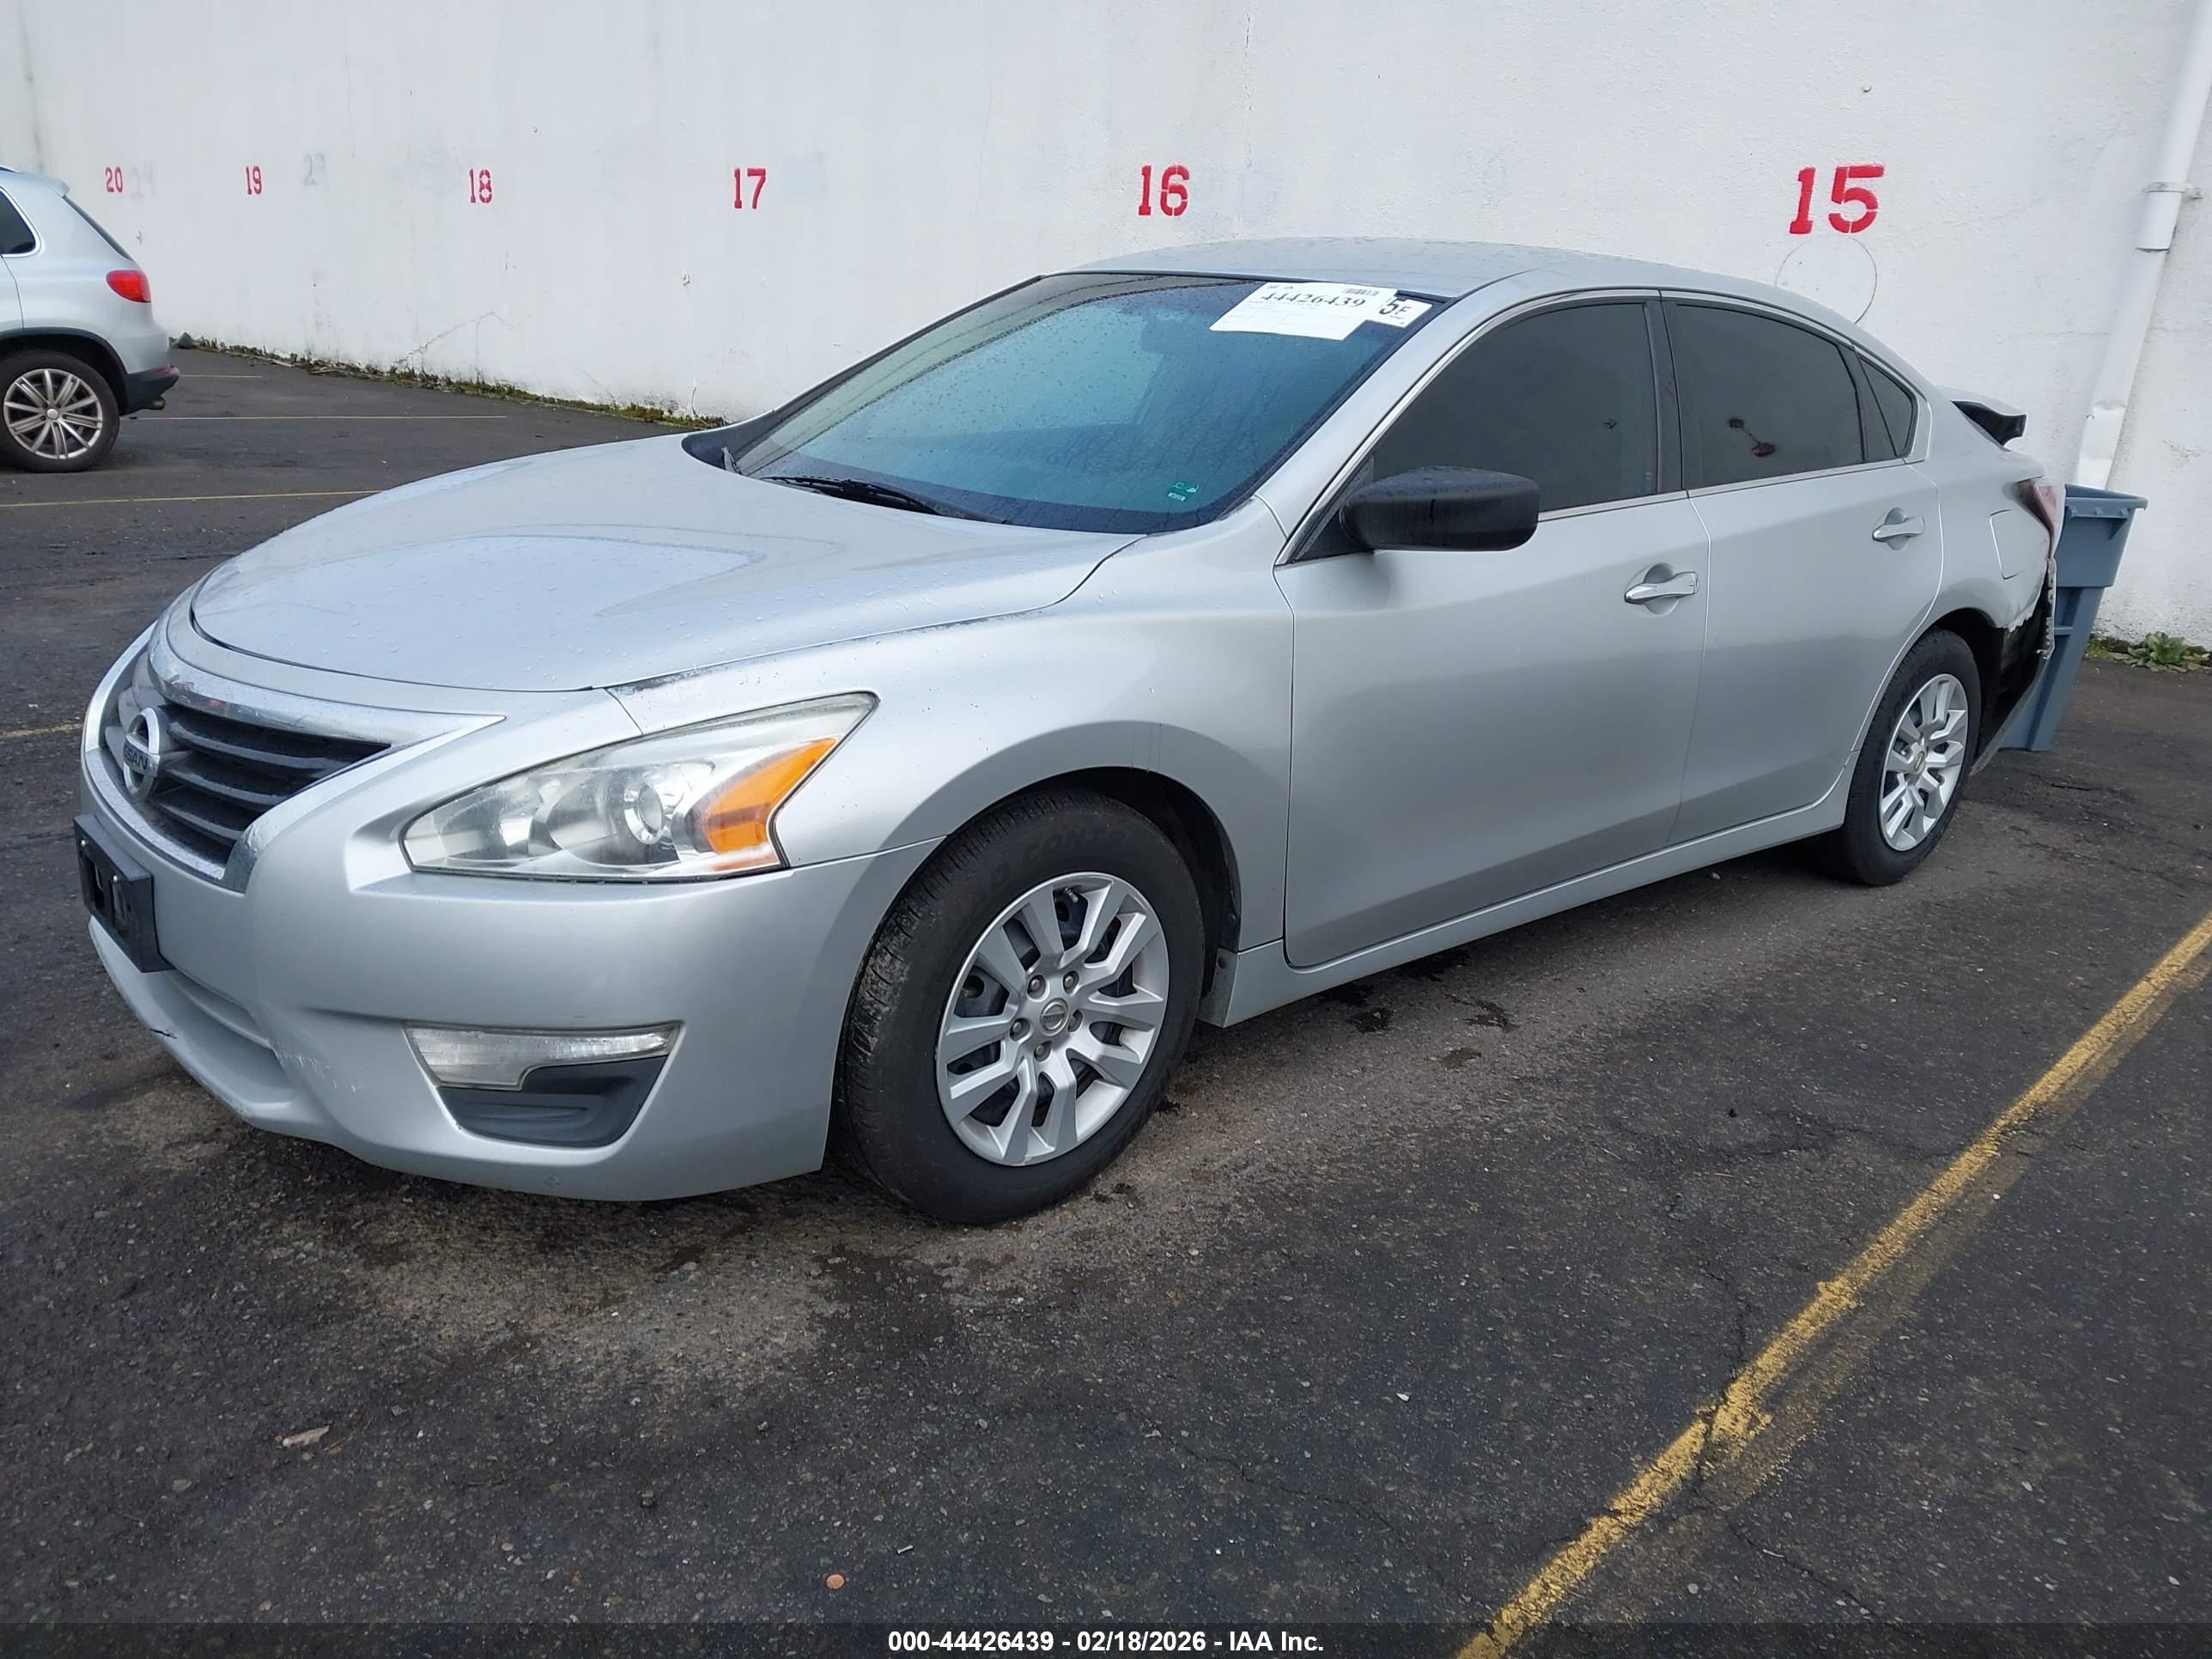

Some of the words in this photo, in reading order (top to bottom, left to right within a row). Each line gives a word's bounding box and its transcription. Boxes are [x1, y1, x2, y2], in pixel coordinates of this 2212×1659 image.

[105, 167, 124, 193] 20
[245, 166, 262, 195] 19
[468, 168, 493, 204] 18
[733, 167, 767, 210] 17
[1138, 165, 1190, 217] 16
[1789, 164, 1885, 235] 15
[1261, 291, 1366, 307] 44426439
